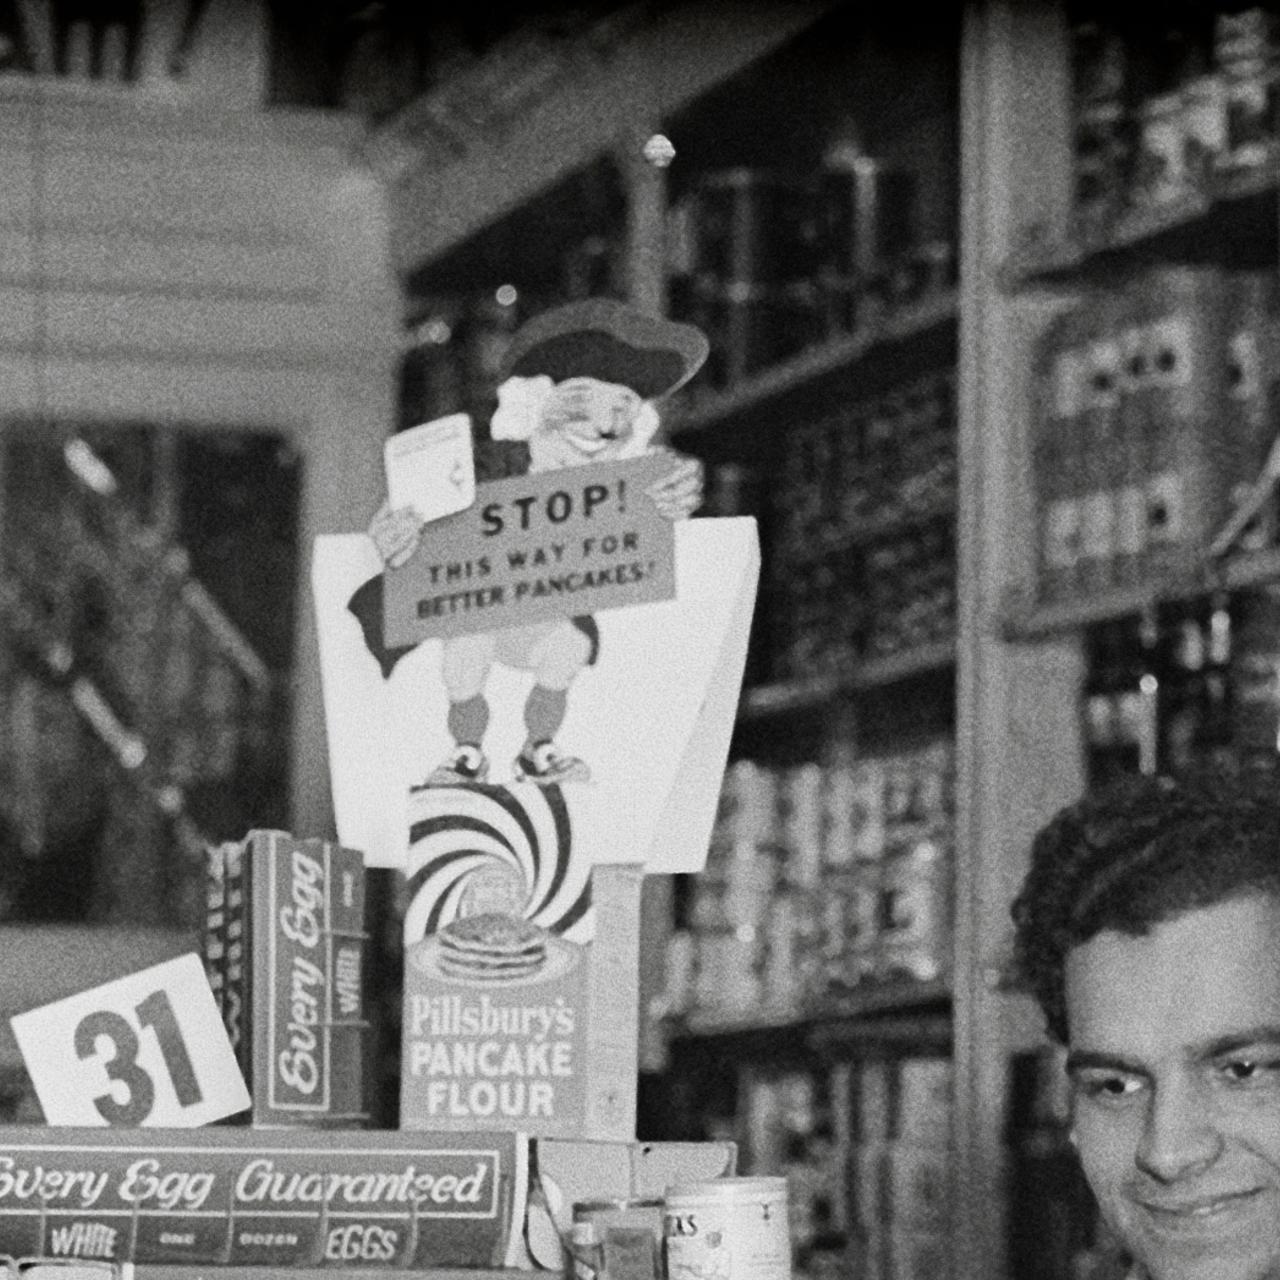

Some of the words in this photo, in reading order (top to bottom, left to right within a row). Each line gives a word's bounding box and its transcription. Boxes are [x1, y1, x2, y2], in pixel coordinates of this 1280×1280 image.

[481, 478, 627, 537] STOP!
[428, 556, 492, 584] THIS
[507, 543, 566, 571] WAY
[582, 531, 640, 557] FOR
[417, 585, 505, 620] BETTER
[278, 849, 323, 949] Egg
[278, 956, 324, 1095] Every
[408, 994, 576, 1041] Pillsbury's
[73, 990, 205, 1126] 31
[409, 1041, 574, 1078] PANCAKE
[427, 1080, 555, 1116] FLOUR
[120, 1158, 216, 1210] Egg
[235, 1158, 488, 1204] Guaranteed
[50, 1221, 118, 1260] WHITE
[239, 1232, 299, 1246] DOZEN
[325, 1224, 398, 1261] EGGS
